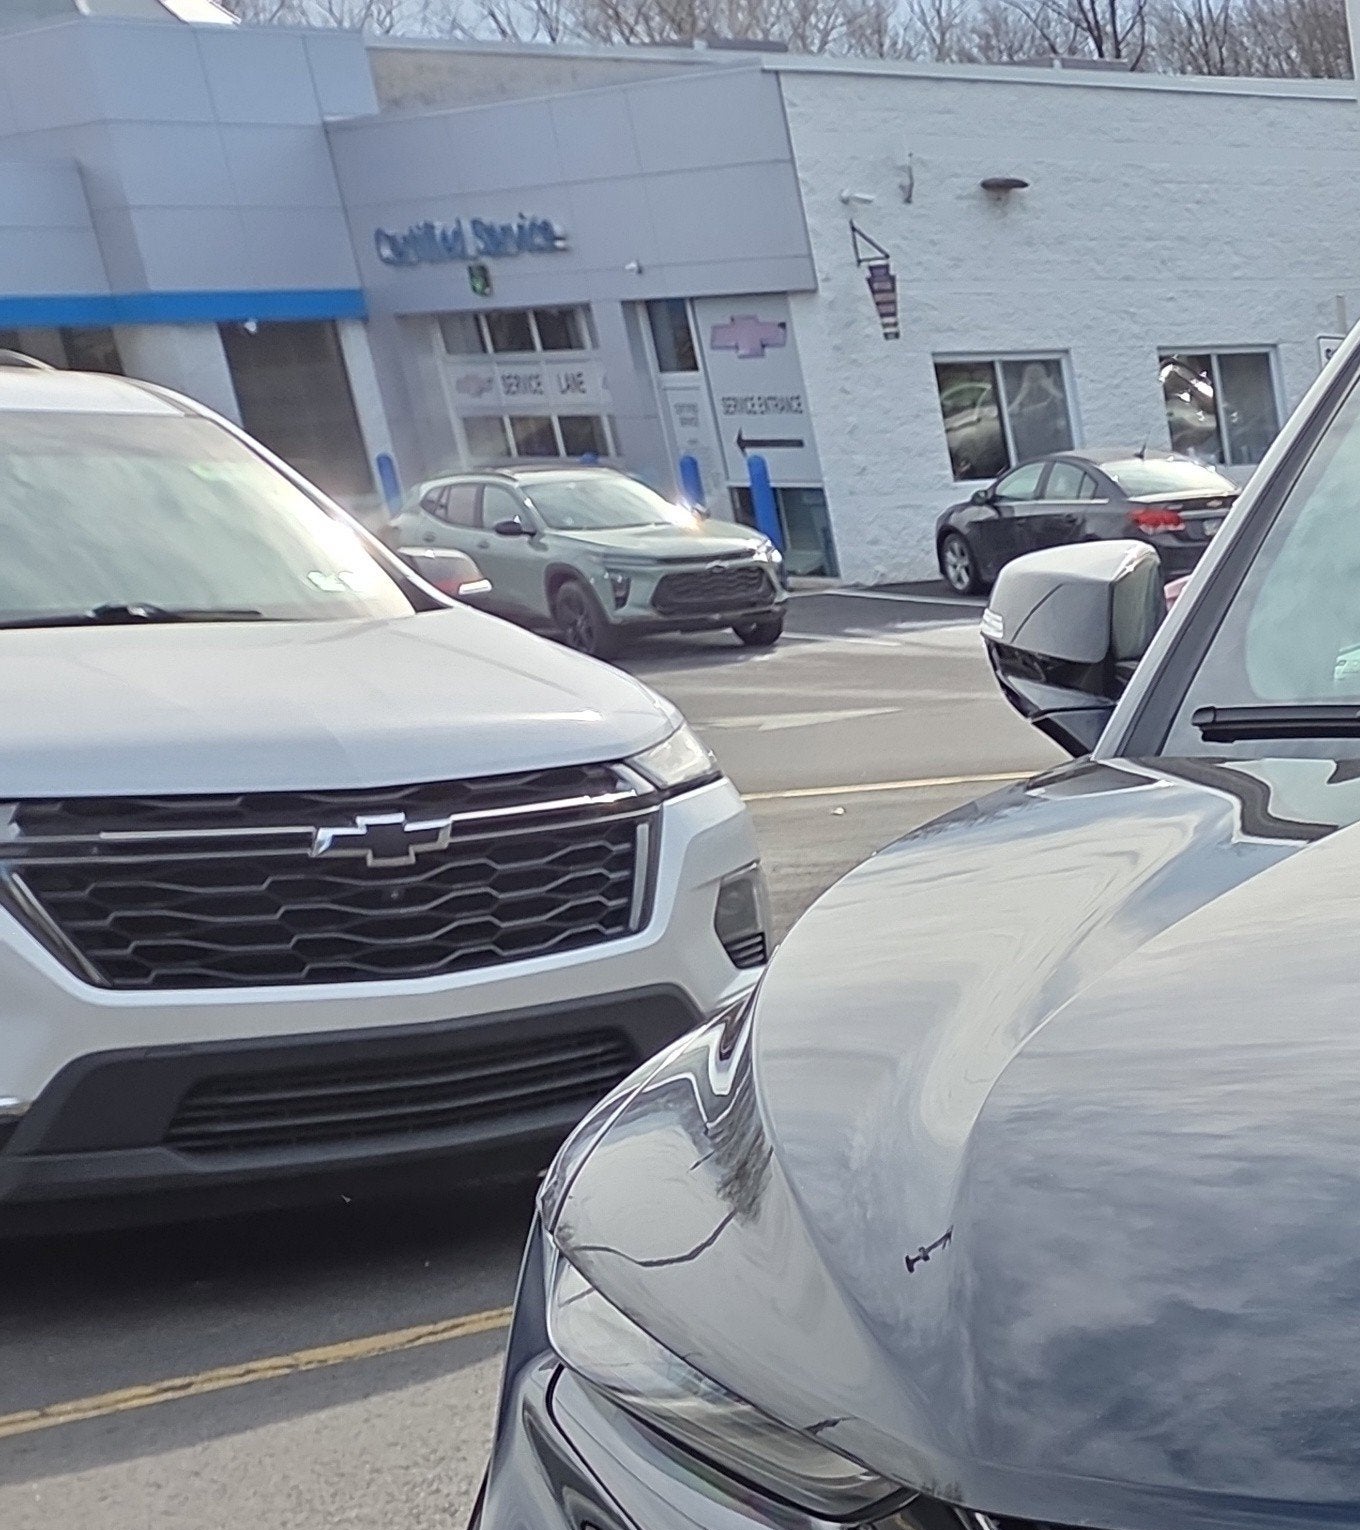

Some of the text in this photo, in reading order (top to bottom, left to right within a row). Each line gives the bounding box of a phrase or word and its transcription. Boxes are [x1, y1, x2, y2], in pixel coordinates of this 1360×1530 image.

[374, 212, 568, 266] Certified Service
[502, 371, 587, 396] SERVICE LANE
[722, 395, 803, 415] SERVICE ENTRANCE
